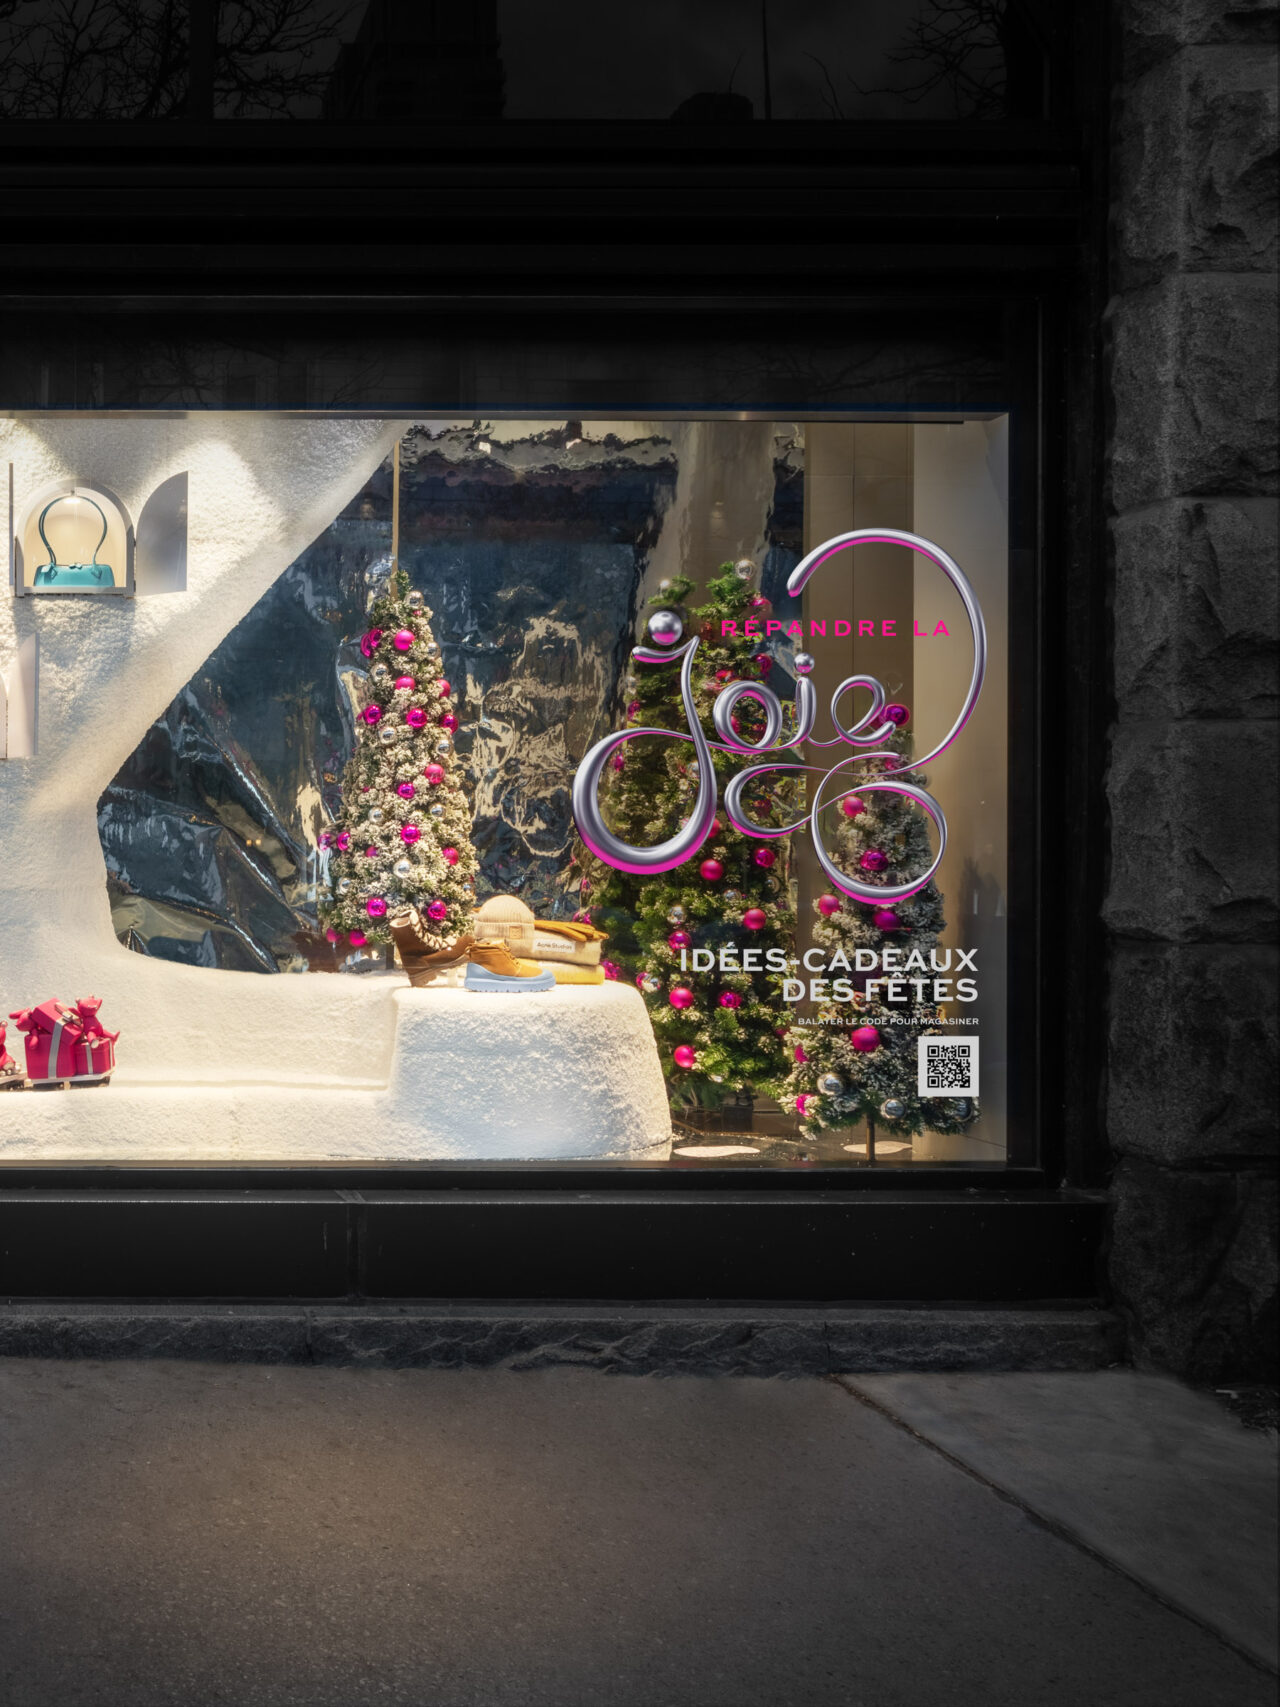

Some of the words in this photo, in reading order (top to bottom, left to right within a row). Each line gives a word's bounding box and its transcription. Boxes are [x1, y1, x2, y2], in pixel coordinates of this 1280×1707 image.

[721, 615, 897, 637] RÉPANDRE
[913, 620, 950, 637] LA
[680, 941, 979, 972] IDÉES-CADEAUX
[782, 978, 854, 1002] DES
[865, 971, 978, 1002] FÊTES
[845, 1017, 858, 1025] LE
[859, 1017, 888, 1025] CODE
[889, 1017, 918, 1025] POUR
[920, 1017, 979, 1025] MAGASINER
